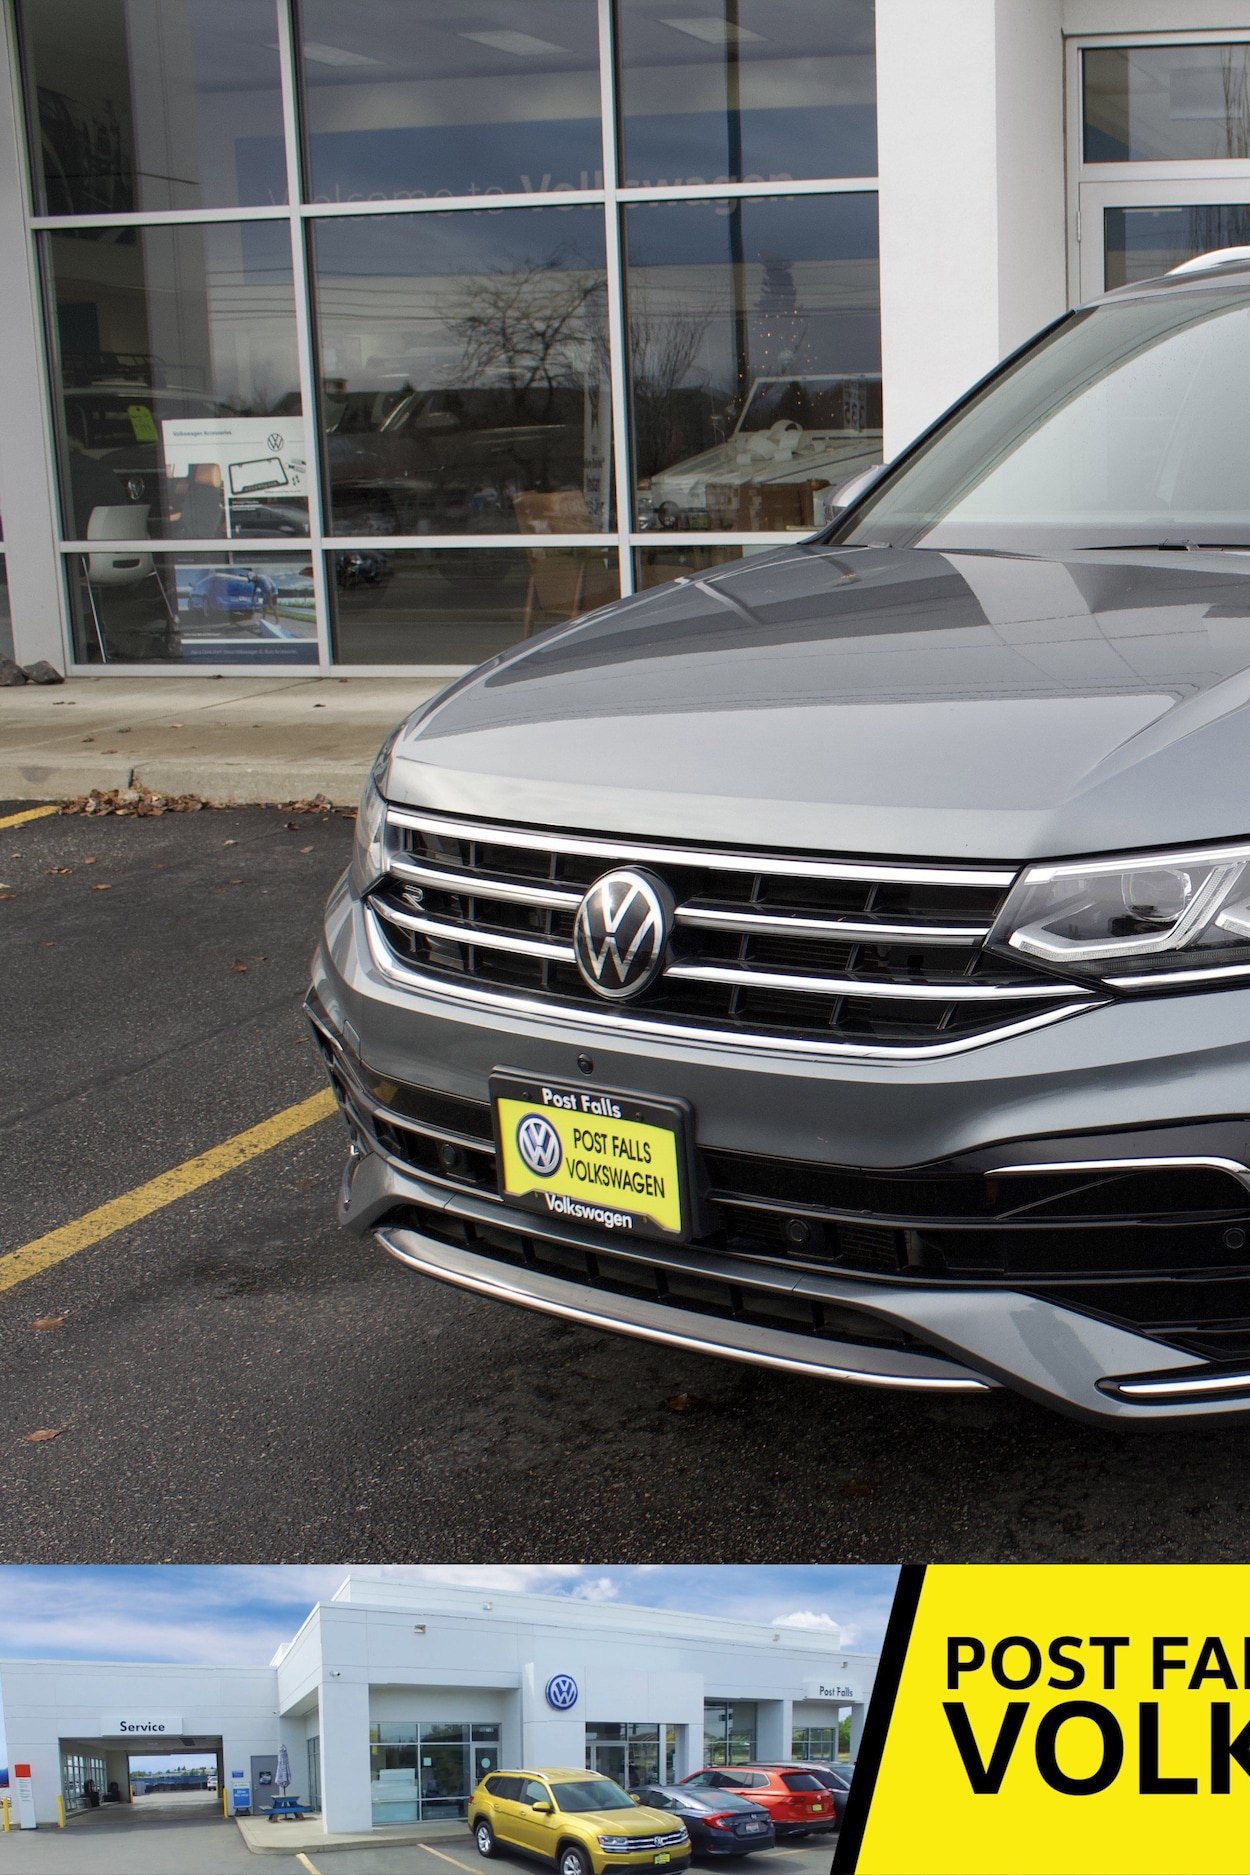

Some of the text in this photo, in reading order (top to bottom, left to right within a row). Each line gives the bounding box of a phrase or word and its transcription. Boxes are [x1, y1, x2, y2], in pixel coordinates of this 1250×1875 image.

[541, 1087, 622, 1119] Post Falls
[573, 1128, 652, 1164] POST FALLS
[565, 1157, 666, 1199] VOLKSWAGEN
[544, 1192, 633, 1229] Volkswagen
